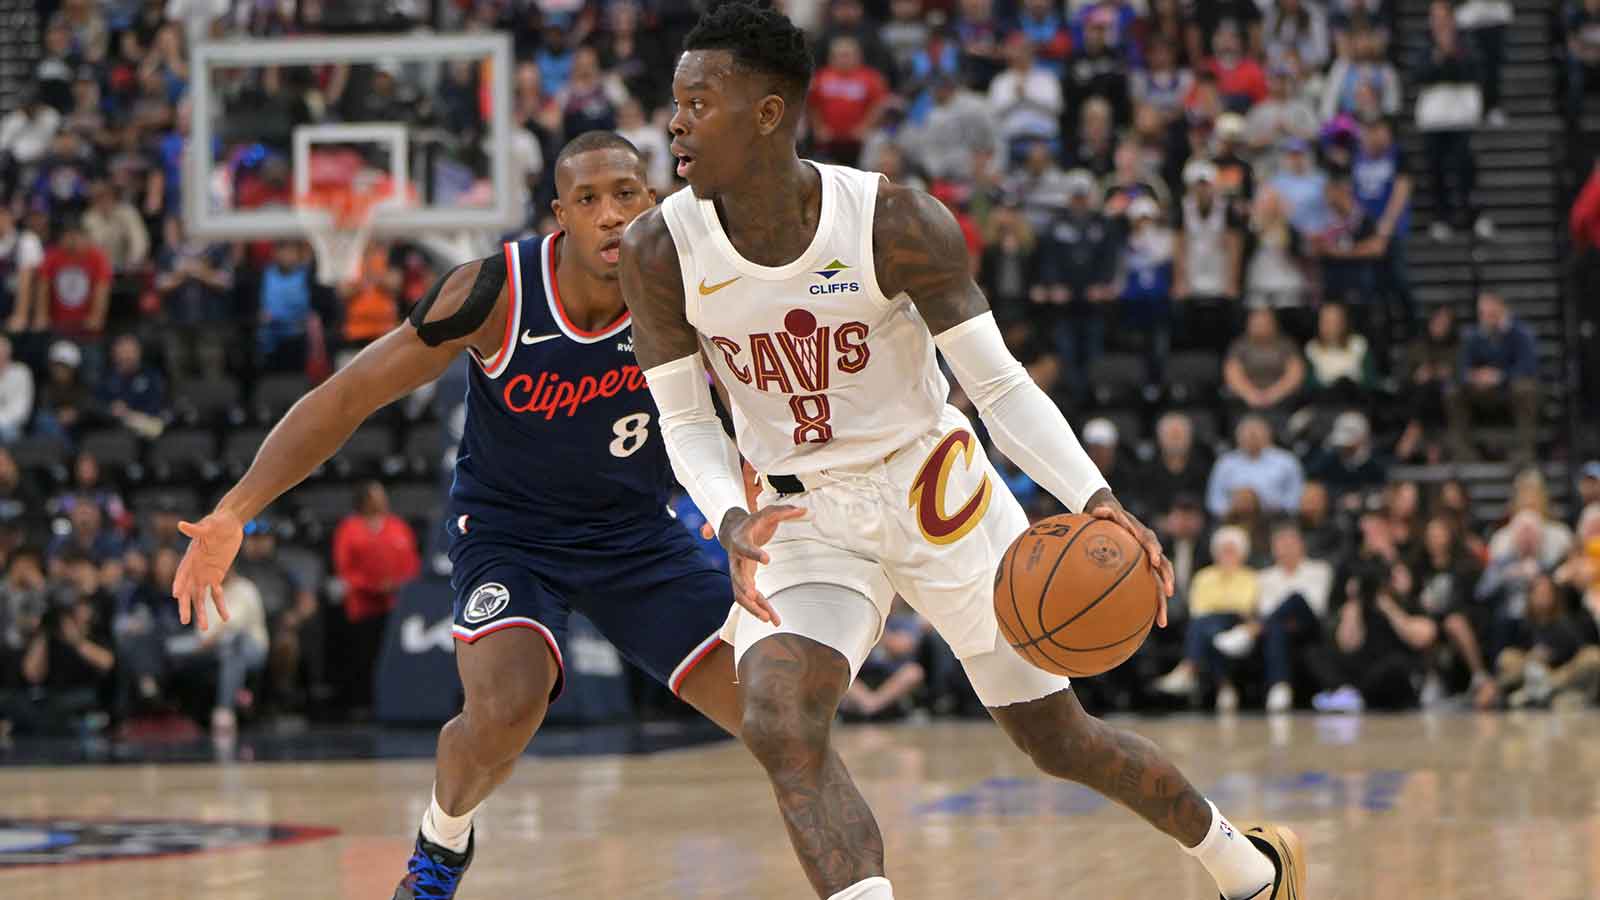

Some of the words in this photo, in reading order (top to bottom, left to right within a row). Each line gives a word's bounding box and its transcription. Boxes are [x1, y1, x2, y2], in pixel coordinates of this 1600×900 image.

[809, 282, 860, 295] CLIFFS
[710, 320, 871, 394] CAVS
[609, 413, 651, 458] 8
[788, 394, 833, 445] 8
